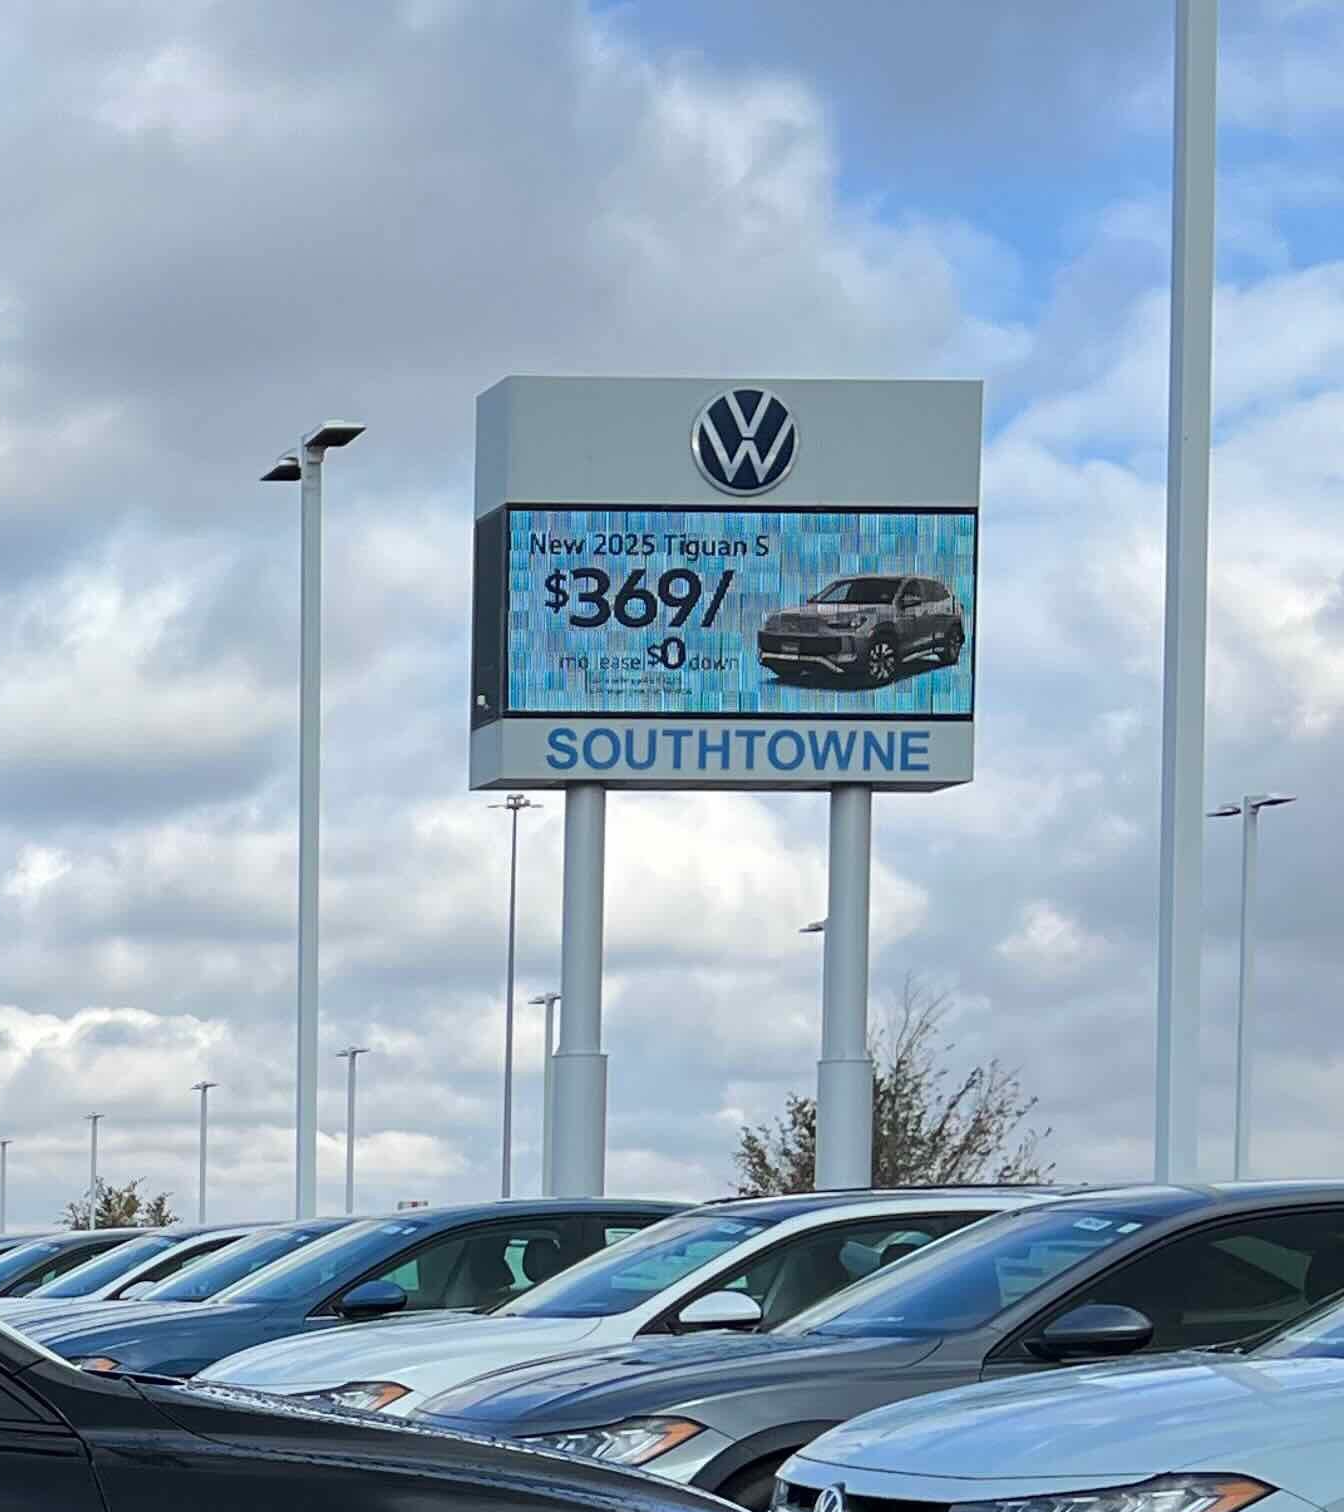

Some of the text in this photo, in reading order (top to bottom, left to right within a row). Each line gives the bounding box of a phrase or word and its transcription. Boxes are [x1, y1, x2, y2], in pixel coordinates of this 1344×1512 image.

[694, 387, 798, 493] VW
[530, 533, 769, 562] New 2025 Tiguan S
[544, 567, 735, 628] $369/
[597, 654, 641, 671] ease
[646, 636, 687, 670] $0
[545, 726, 932, 772] SOUTHTOWNE
